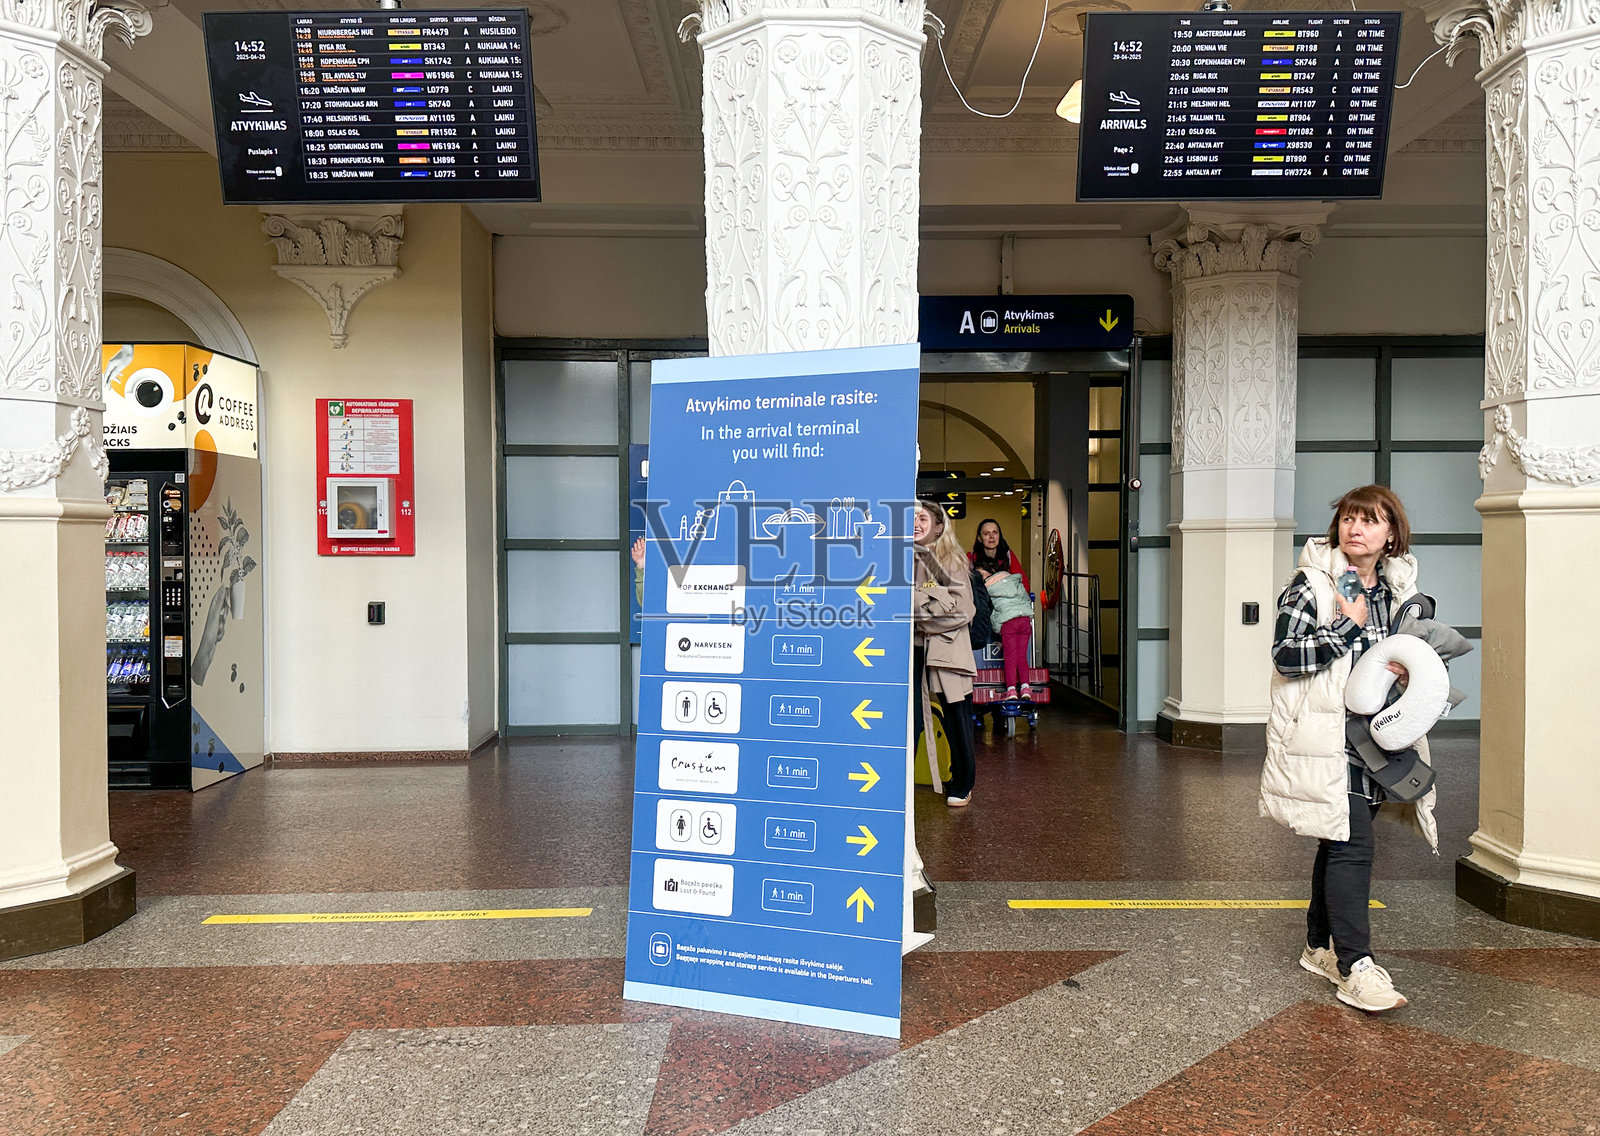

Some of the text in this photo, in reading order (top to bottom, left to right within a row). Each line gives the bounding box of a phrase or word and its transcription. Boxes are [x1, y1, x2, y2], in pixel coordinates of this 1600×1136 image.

[234, 41, 265, 52] 14:52
[1113, 42, 1142, 52] 14:52
[231, 120, 287, 132] ATVYKIMAS
[1100, 120, 1147, 130] ARRIVALS
[1004, 310, 1054, 322] Atvykimas
[959, 311, 976, 334] A
[1004, 324, 1040, 333] Arrivals
[219, 397, 253, 417] COFFEE
[686, 390, 878, 415] Atvykimo terminale rasite:
[219, 415, 254, 431] ADDRESS
[702, 419, 859, 440] In the arrival terminal
[732, 442, 824, 463] you will find:
[793, 584, 814, 593] 1 min
[790, 644, 812, 654] 1 min
[788, 706, 810, 715] 1 min
[1373, 710, 1401, 731] WellPur
[792, 767, 808, 776] min
[783, 828, 805, 839] 1 min
[781, 890, 803, 901] 1 min
[697, 947, 722, 955] pakavimo
[729, 951, 756, 959] saugojimo
[826, 962, 844, 971] salėje.
[676, 954, 698, 963] Baggage
[700, 958, 724, 967] wrapping
[736, 962, 756, 970] storage
[785, 968, 809, 976] available
[828, 973, 859, 984] Departures
[861, 977, 874, 985] hall.
